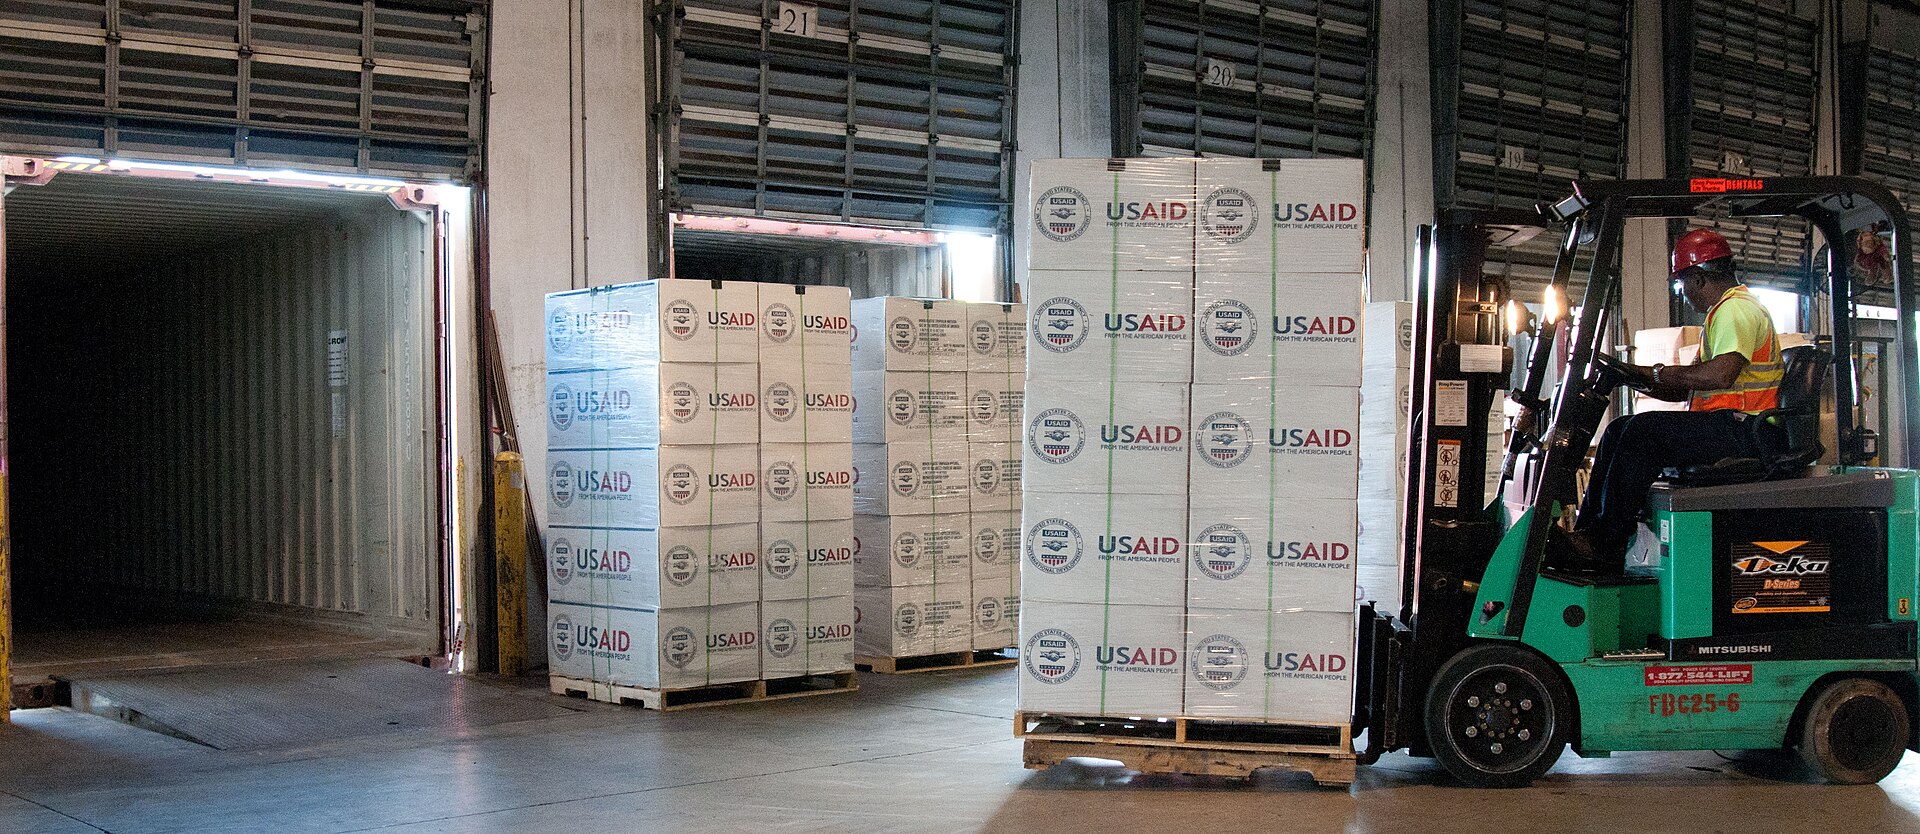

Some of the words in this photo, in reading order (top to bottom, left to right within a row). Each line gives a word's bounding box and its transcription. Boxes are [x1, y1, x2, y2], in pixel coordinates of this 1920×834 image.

[784, 8, 807, 35] 21
[1212, 66, 1231, 86] 20
[1510, 151, 1521, 168] 19
[1726, 180, 1762, 189] RENTALS
[1107, 202, 1187, 220] USAID
[1273, 203, 1357, 222] USAID
[708, 312, 754, 326] USAID
[804, 315, 847, 329] USAID
[1105, 314, 1185, 332] USAID
[1272, 316, 1355, 335] USAID
[577, 391, 630, 413] USAID
[709, 394, 755, 406] USAID
[806, 394, 849, 407] USAID
[1100, 425, 1182, 444] USAID
[1269, 428, 1351, 447] USAID
[578, 471, 631, 492] USAID
[709, 474, 755, 487] USAID
[807, 472, 849, 484] USAID
[807, 548, 850, 561] USAID
[1098, 536, 1179, 555] USAID
[1267, 542, 1349, 561] USAID
[577, 549, 630, 572] USAID
[1737, 556, 1829, 574] Deka
[1763, 580, 1800, 589] D-Series
[577, 625, 630, 652] USAID
[706, 632, 755, 648] USAID
[806, 624, 851, 639] USAID
[1096, 646, 1177, 666] USAID
[1699, 645, 1771, 654] MITSUBISHI
[1264, 653, 1346, 672] USAID
